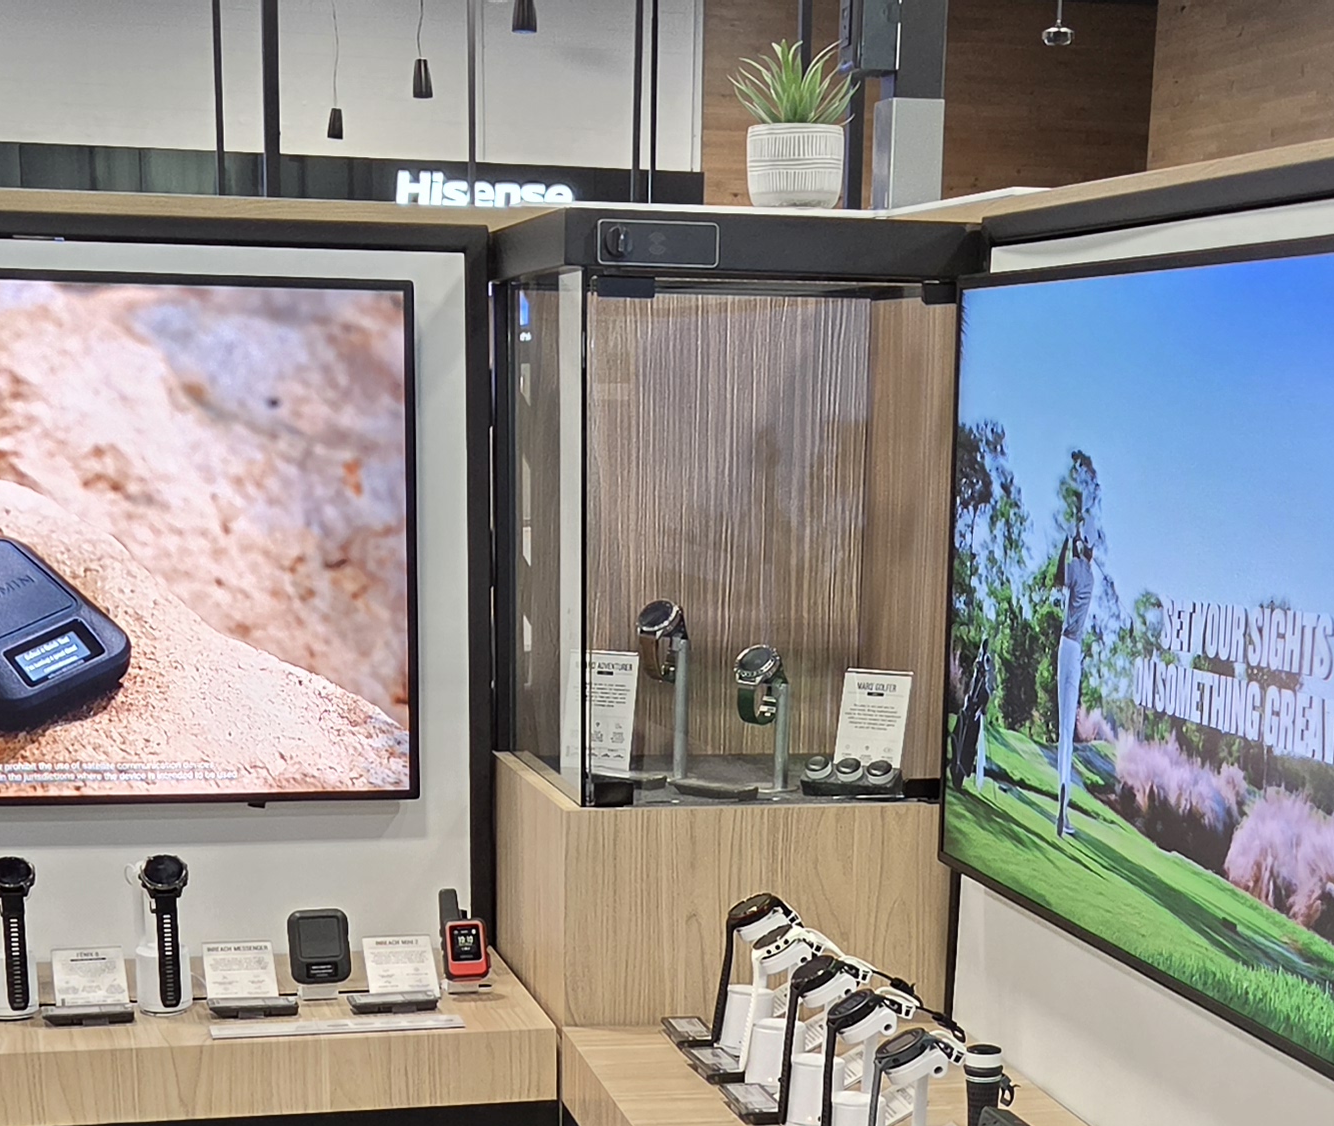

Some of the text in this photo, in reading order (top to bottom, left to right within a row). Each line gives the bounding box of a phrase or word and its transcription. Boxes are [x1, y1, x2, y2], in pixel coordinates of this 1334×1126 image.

[396, 169, 574, 207] Hisense
[1161, 598, 1334, 680] SET YOUR SIGHTS
[1133, 656, 1156, 708] ON
[1155, 663, 1262, 742] SOMETHING
[9, 772, 23, 781] the
[104, 771, 117, 780] the
[38, 762, 52, 771] the
[54, 763, 69, 771] use
[71, 761, 81, 770] of
